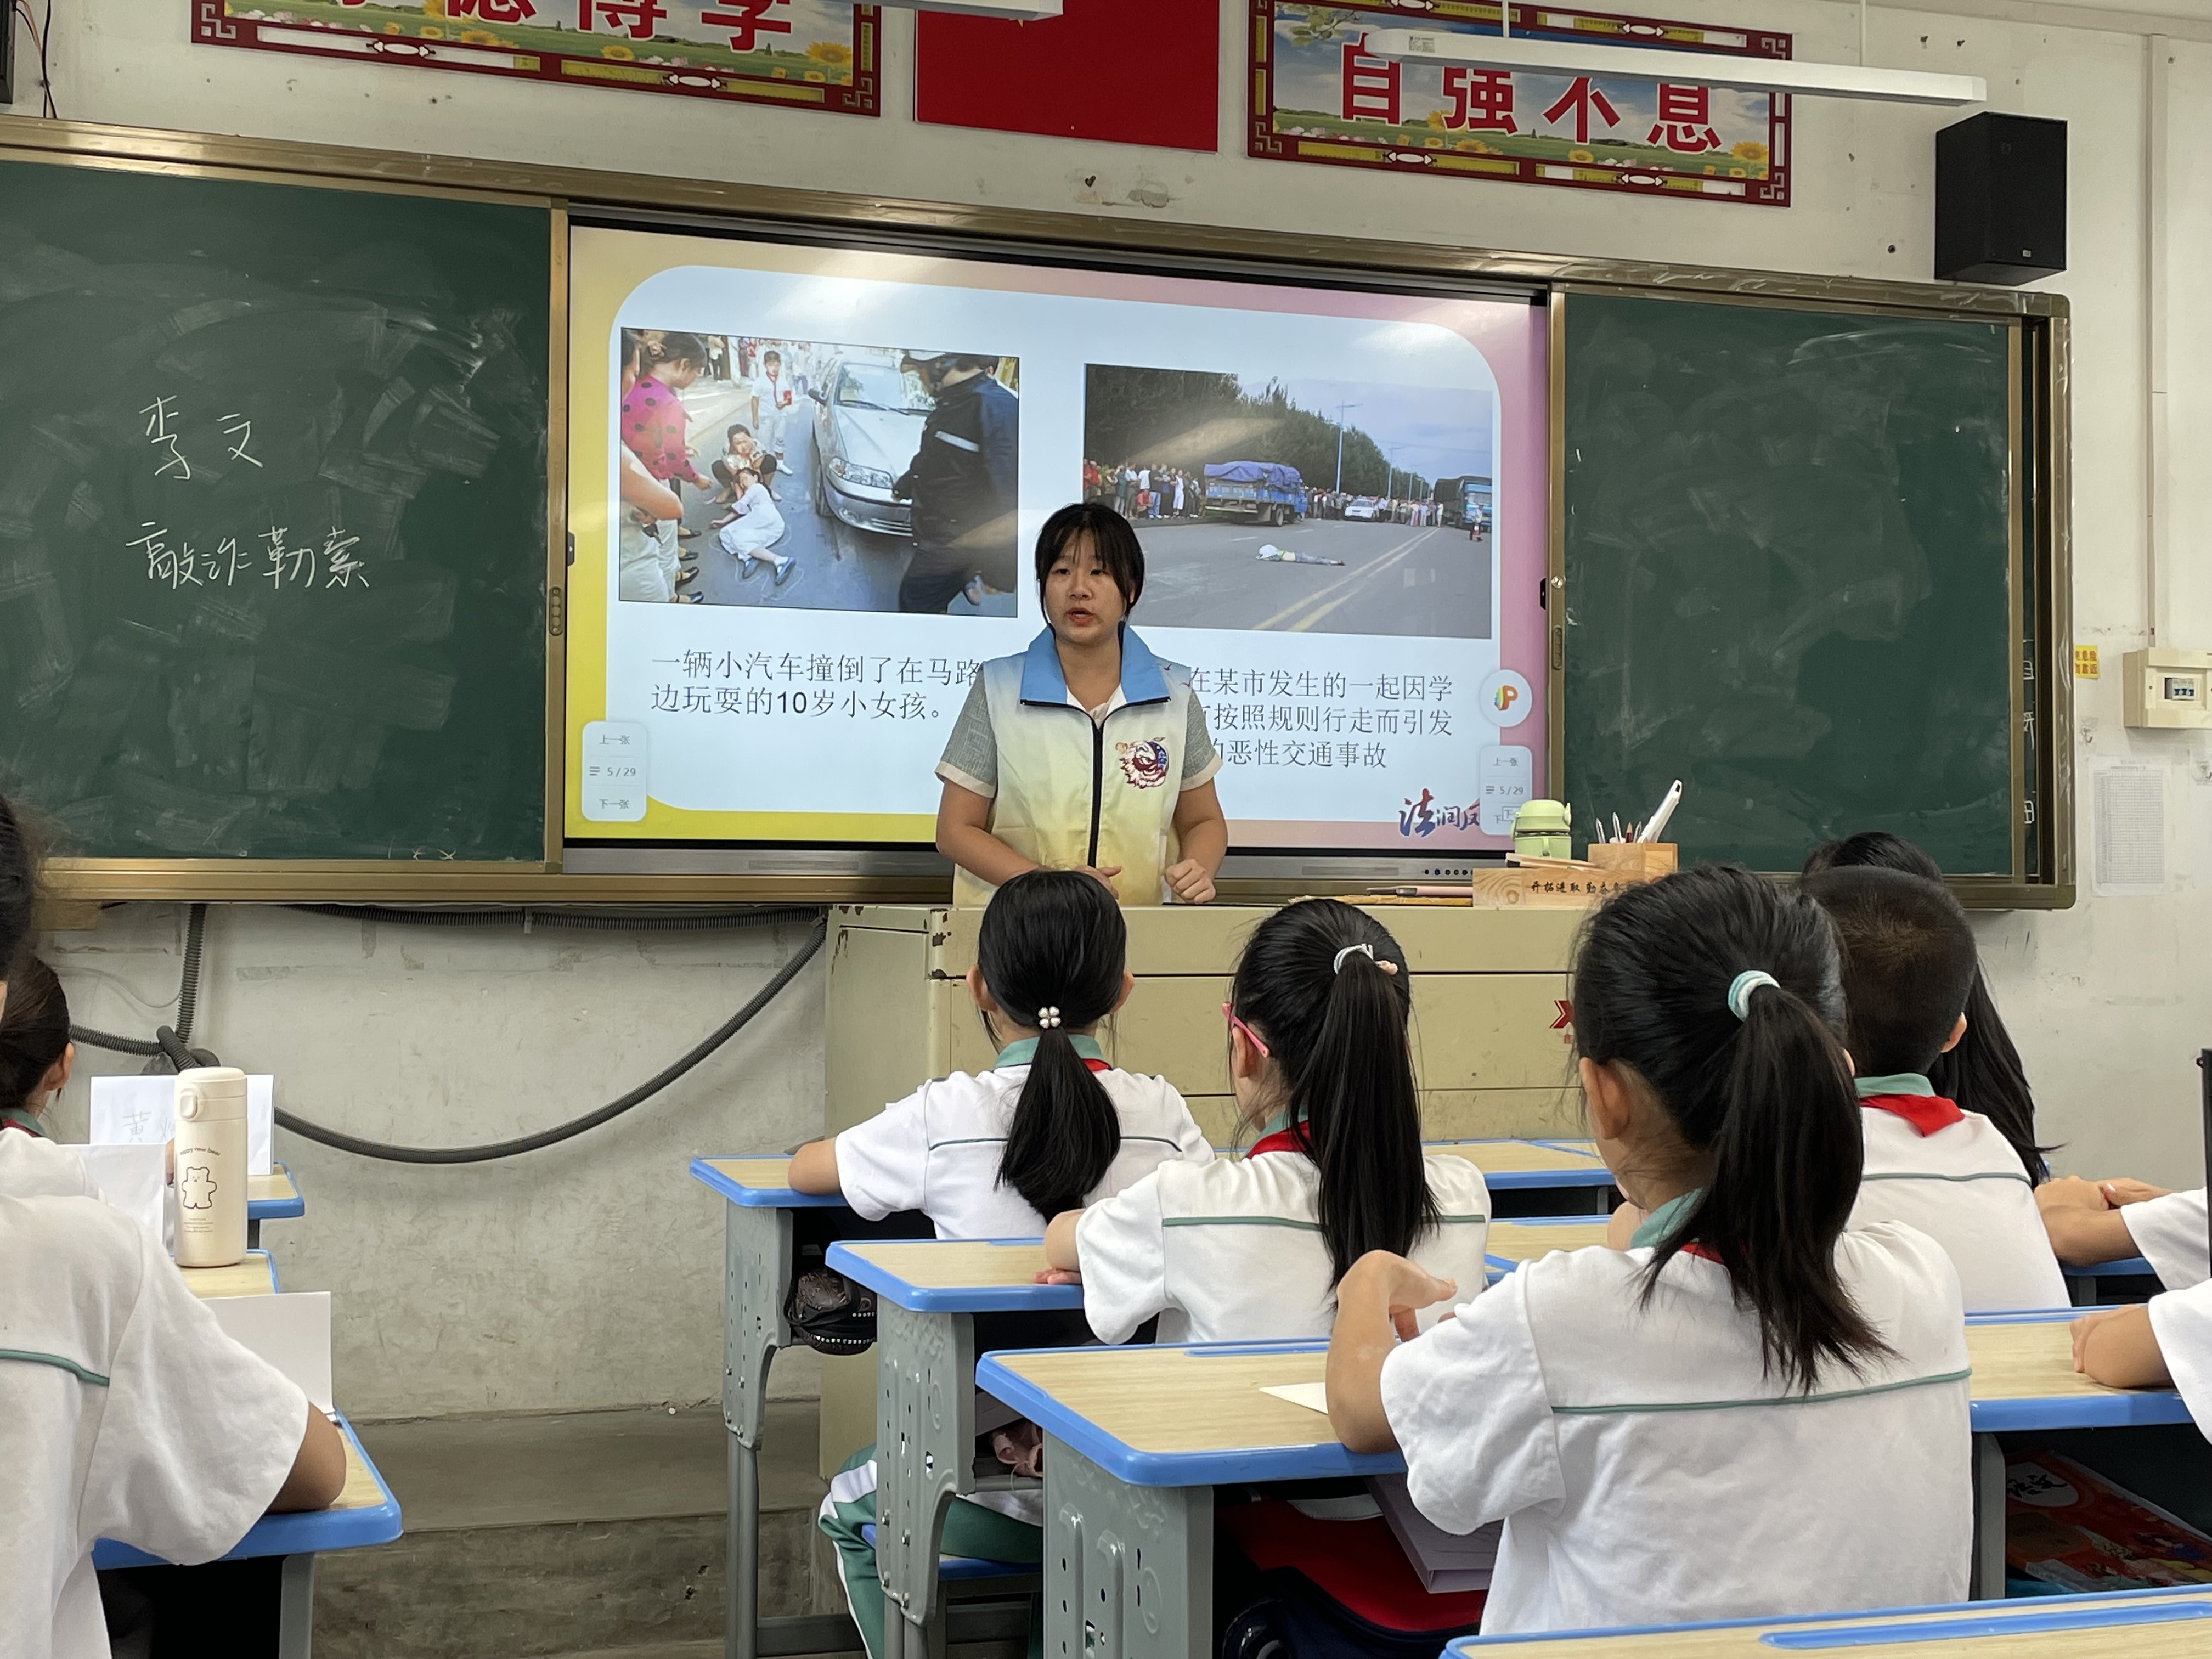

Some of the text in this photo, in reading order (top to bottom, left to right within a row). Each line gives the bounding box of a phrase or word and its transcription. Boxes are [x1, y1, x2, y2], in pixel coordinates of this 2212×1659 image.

[1341, 32, 1720, 153] 自强不息
[125, 521, 369, 590] 敲诈勒索
[651, 648, 980, 687] 一辆小汽车撞倒了在马路
[1202, 703, 1453, 736] 按照规则行走而引发
[599, 734, 630, 745] 上一张
[599, 798, 630, 810] 下一张
